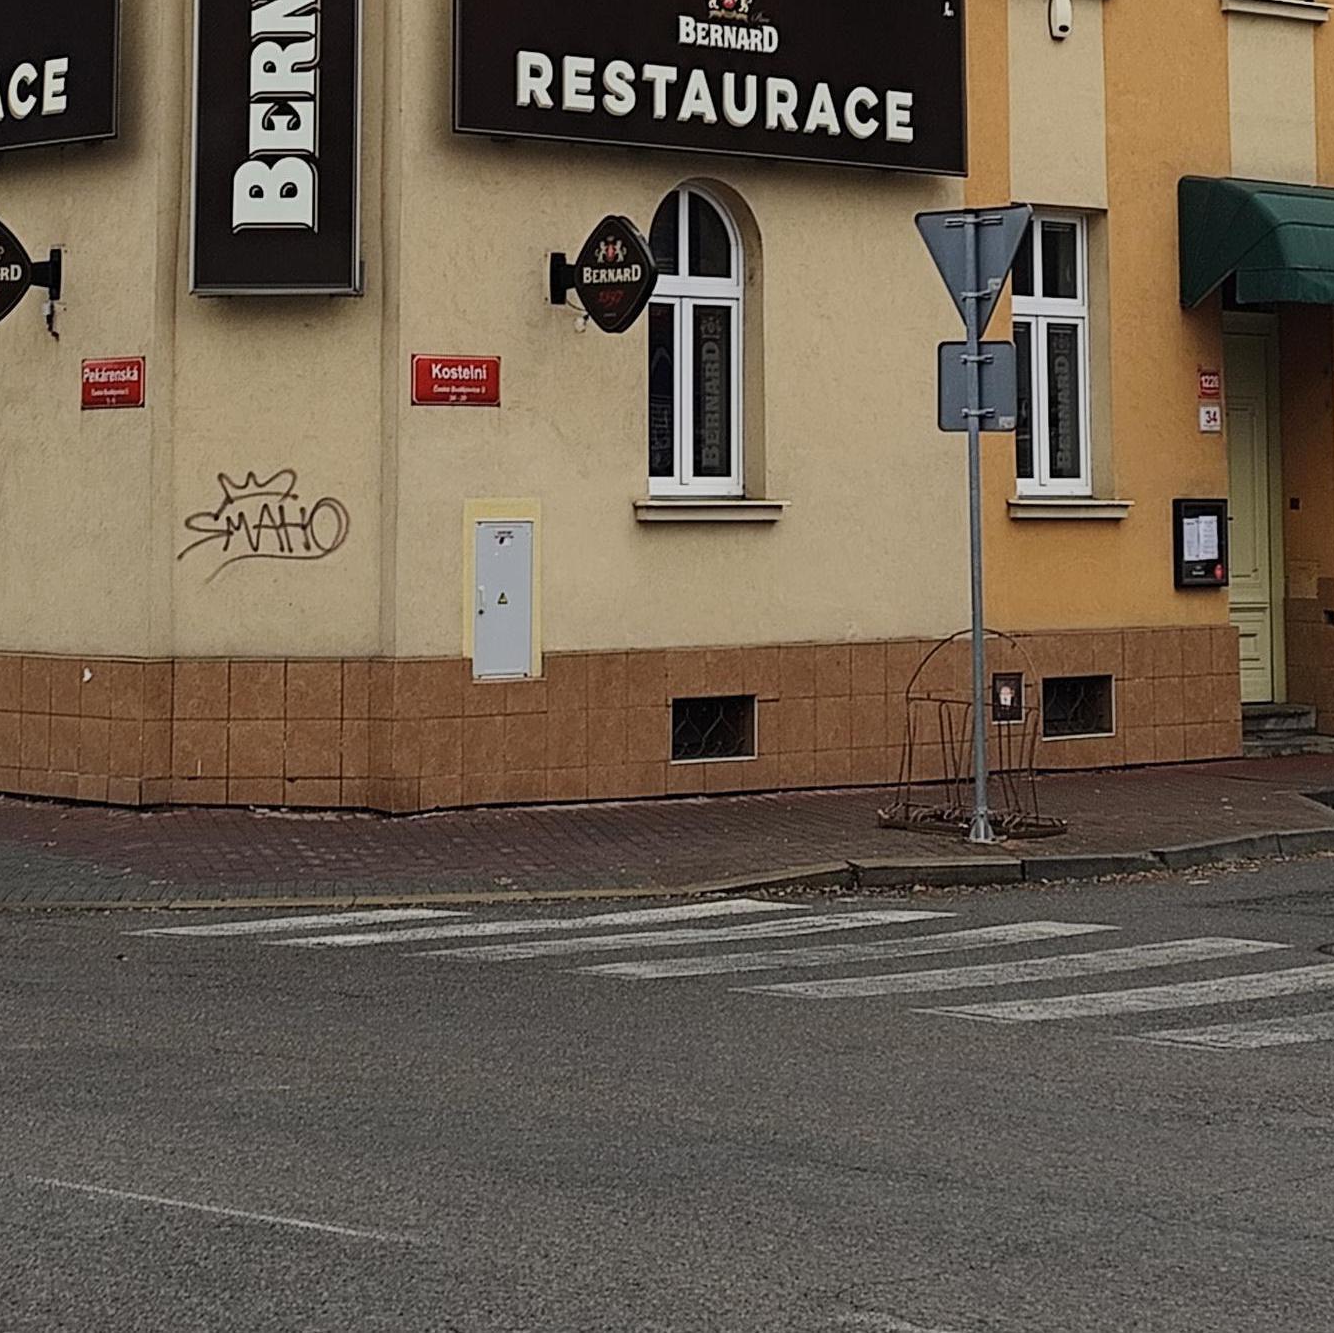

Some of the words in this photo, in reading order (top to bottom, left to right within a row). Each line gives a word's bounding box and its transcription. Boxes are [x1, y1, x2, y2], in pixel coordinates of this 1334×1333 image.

[678, 15, 778, 53] BERNARD
[515, 50, 915, 144] RESTAURACE
[583, 264, 642, 284] BERNARD
[431, 363, 487, 380] Kostelní
[701, 340, 720, 469] BERNARD
[1205, 411, 1218, 424] 34
